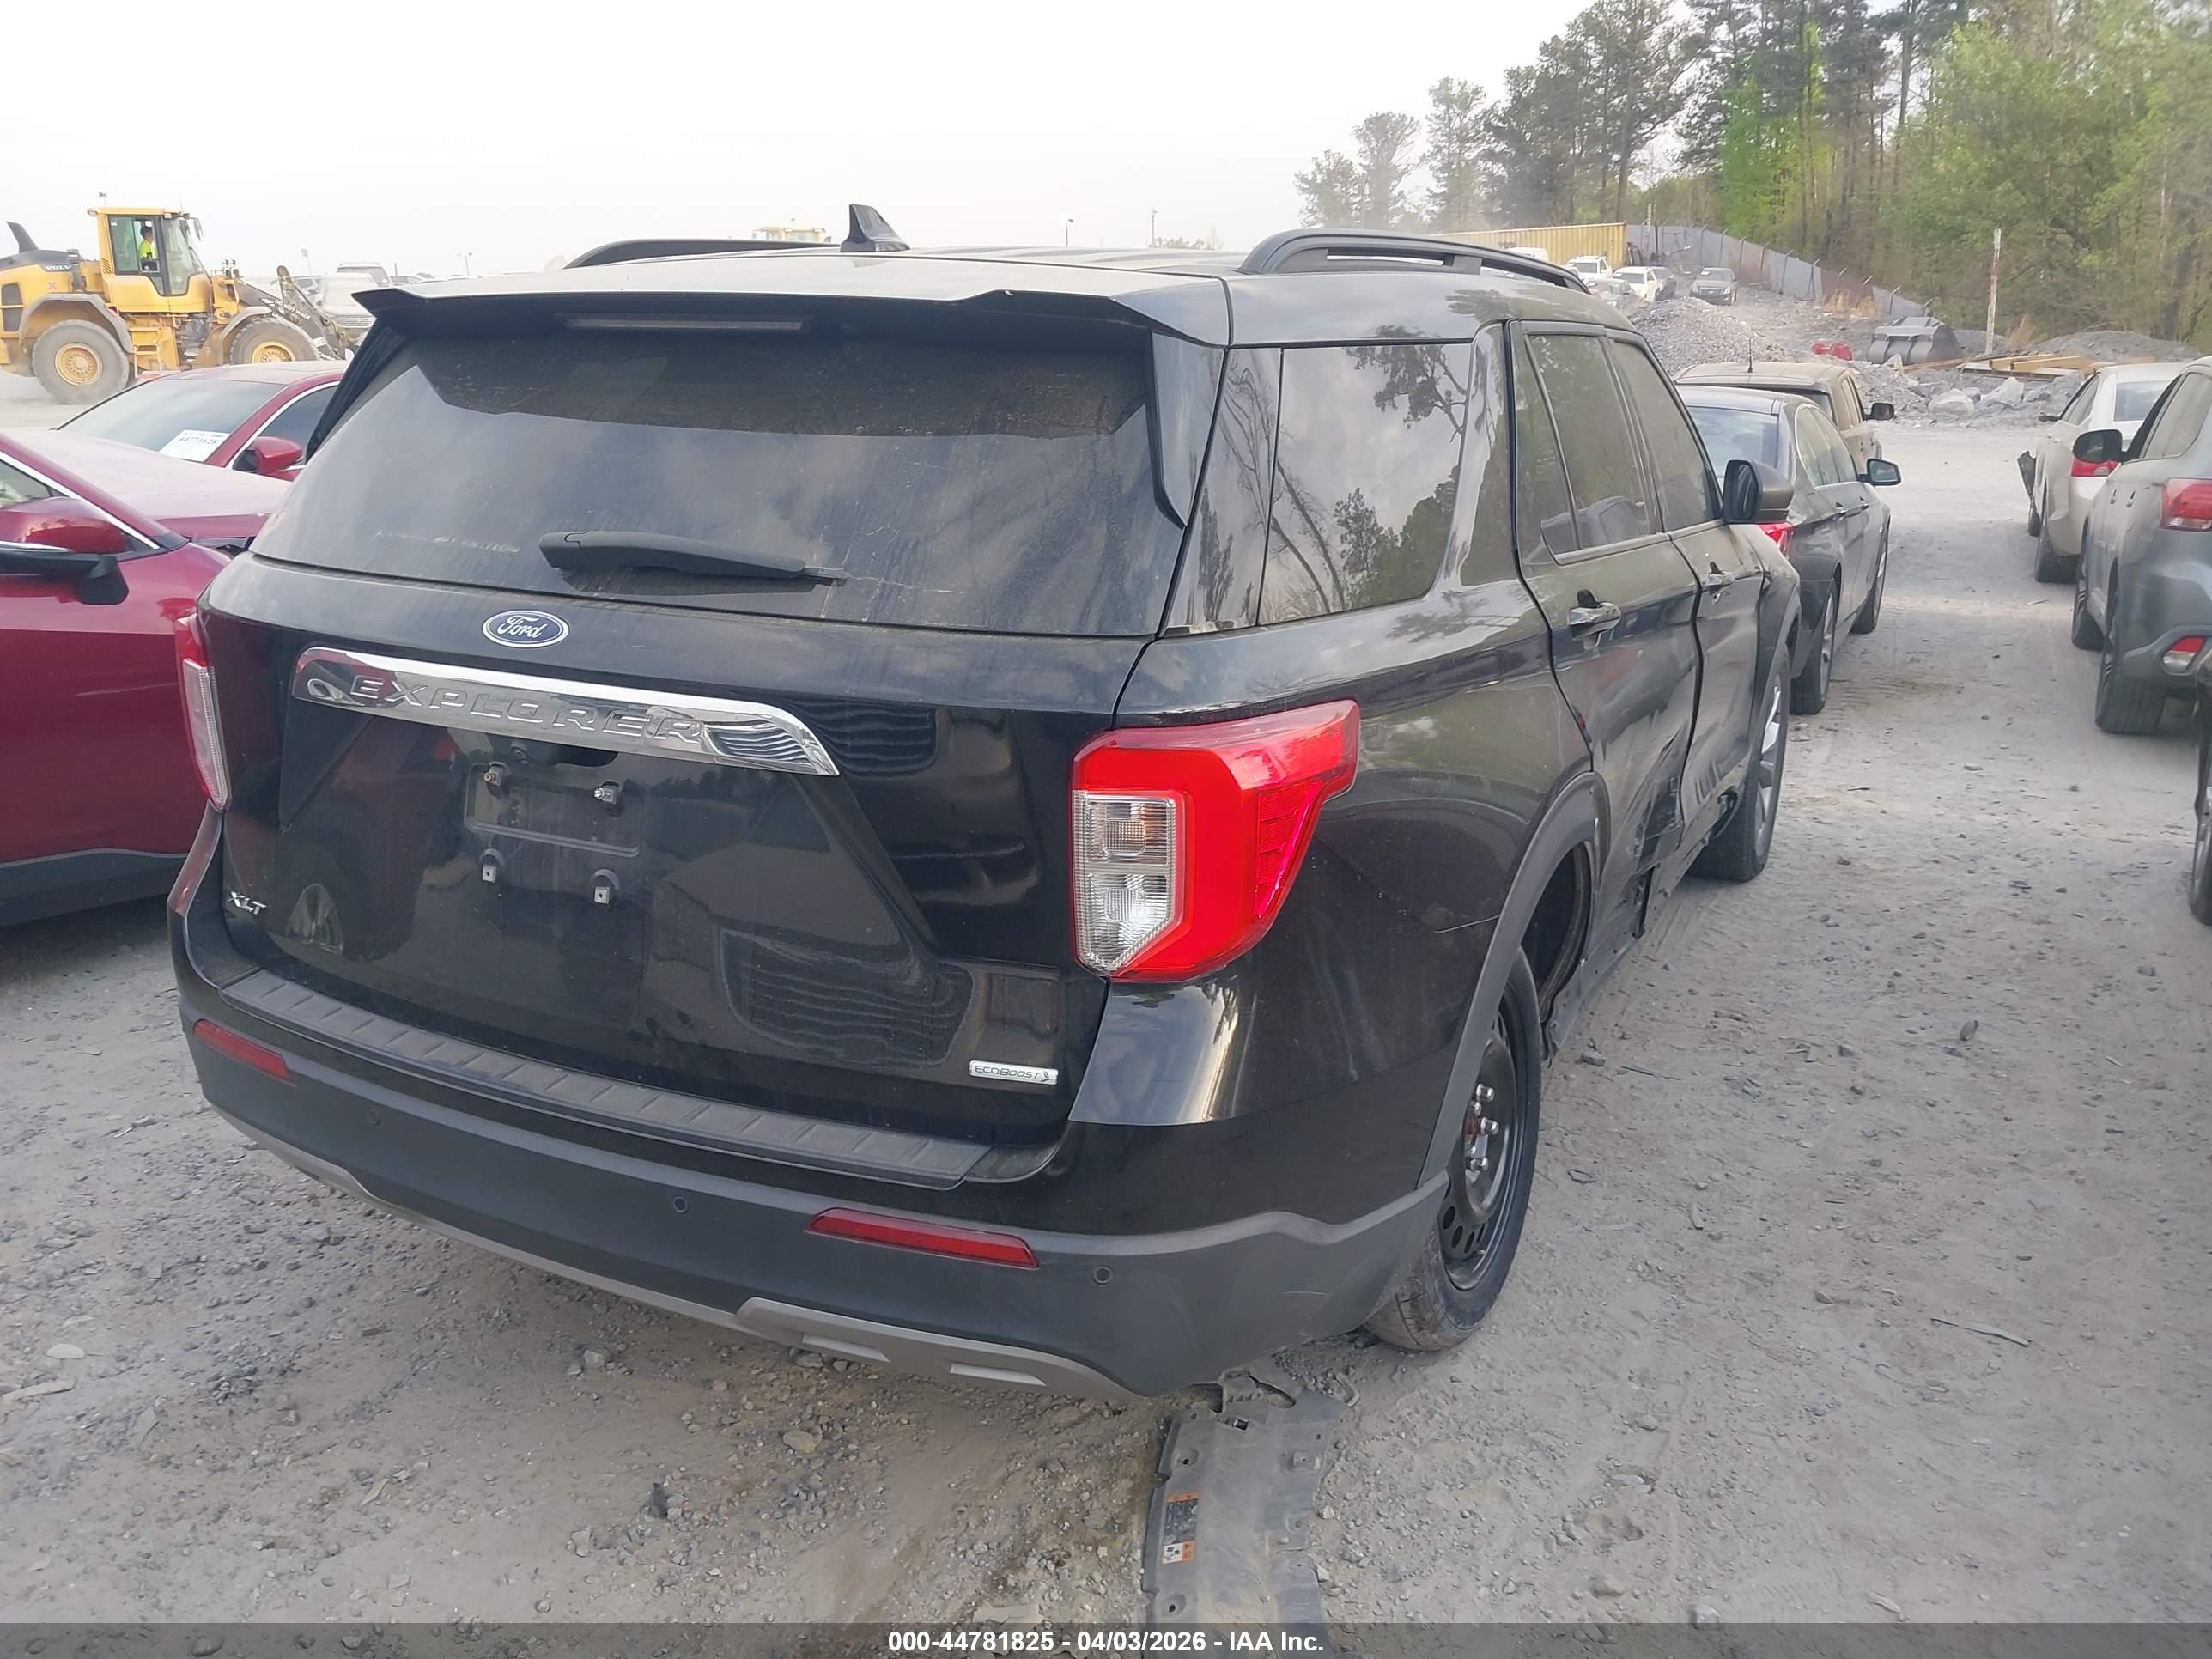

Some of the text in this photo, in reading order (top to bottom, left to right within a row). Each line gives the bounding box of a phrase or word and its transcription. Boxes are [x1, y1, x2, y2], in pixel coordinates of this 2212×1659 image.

[295, 310, 311, 320] WALK
[496, 614, 548, 638] Ford
[349, 674, 703, 745] EXPLORER
[227, 890, 267, 915] XLT
